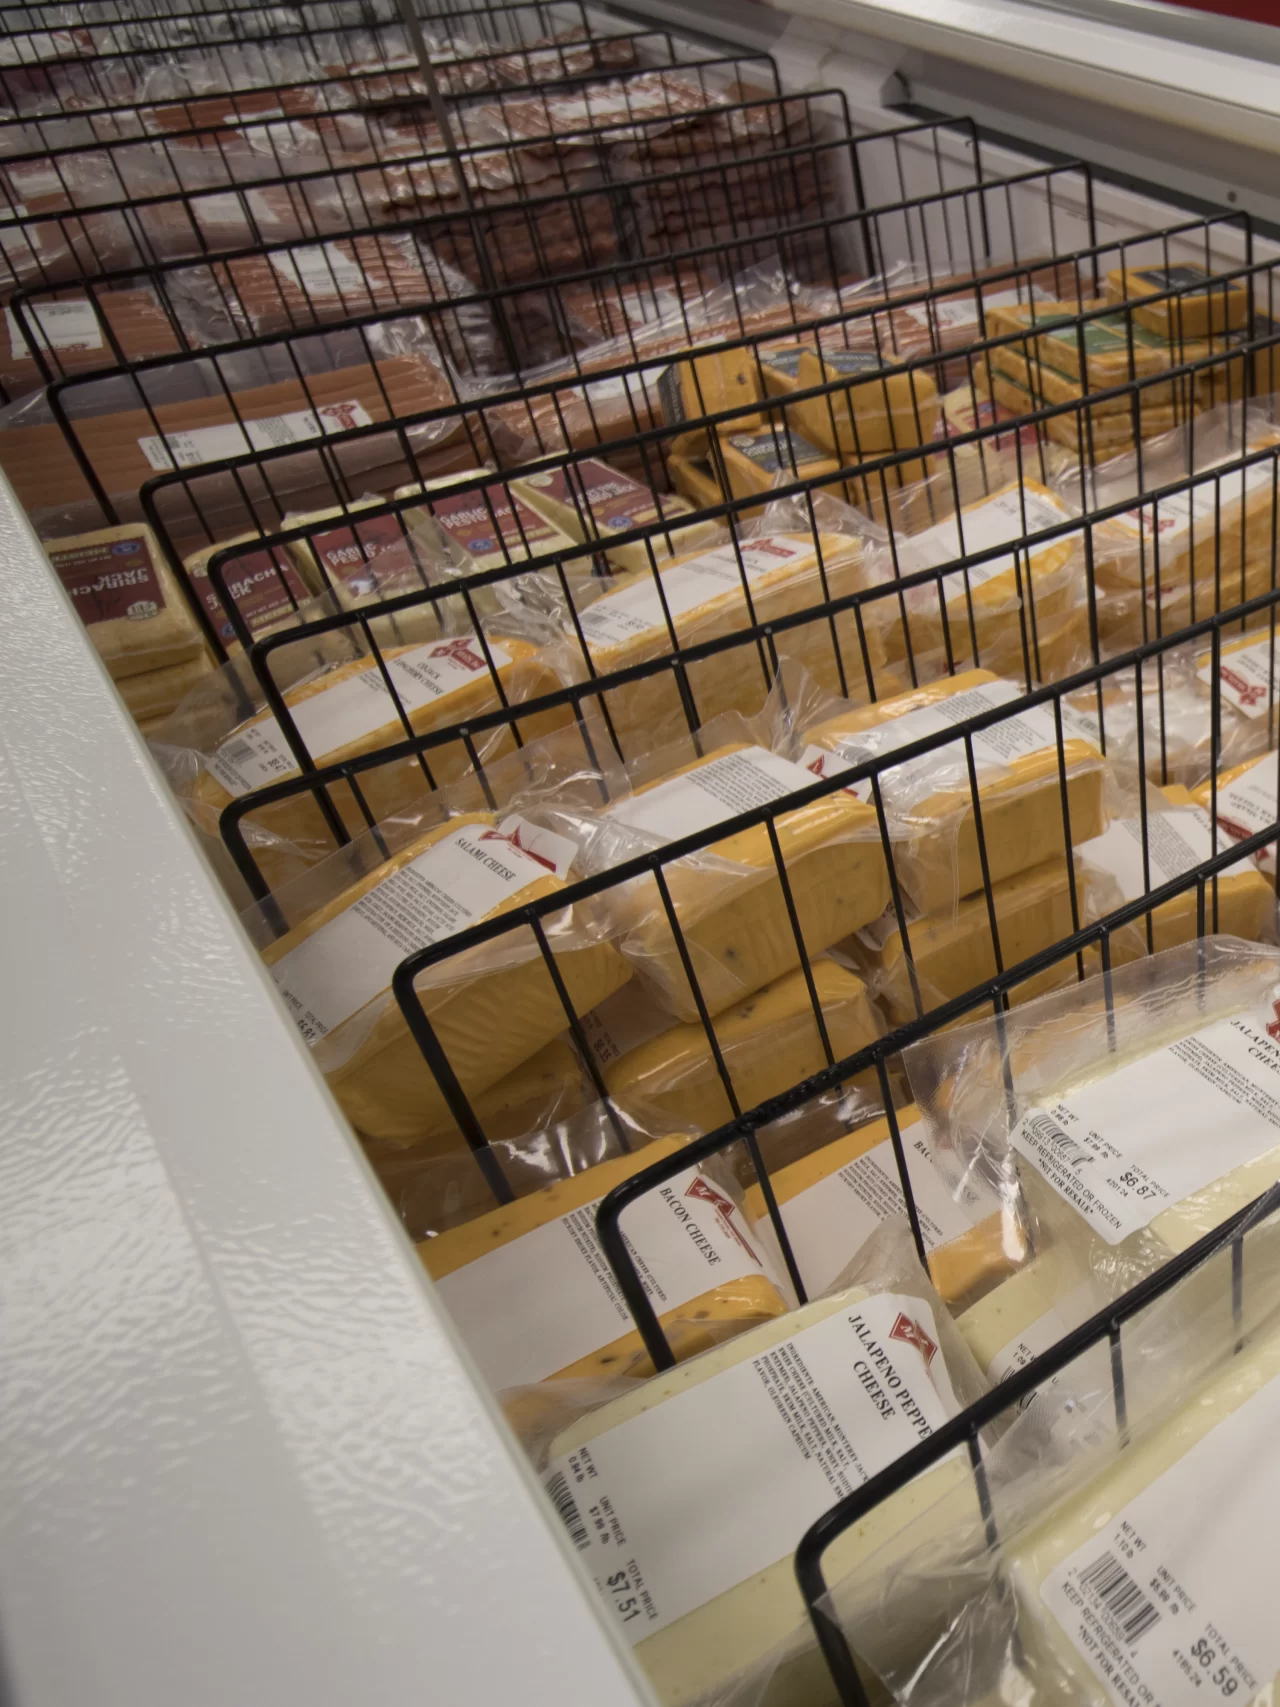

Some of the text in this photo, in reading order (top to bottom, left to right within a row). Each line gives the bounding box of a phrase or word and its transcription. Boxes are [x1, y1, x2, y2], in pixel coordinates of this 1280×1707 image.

[454, 837, 517, 882] SALAMI CHEESE
[1056, 1103, 1080, 1122] NET WT
[1087, 1130, 1123, 1159] UNIT PRICE
[1020, 1129, 1123, 1230] KEEP REFRIGERATED OR FROZEN
[1049, 1172, 1066, 1189] FOR
[1119, 1171, 1157, 1200] $6.87
[1130, 1163, 1171, 1199] TOTAL PRICE
[659, 1187, 722, 1267] BACON CHEESE
[847, 1315, 938, 1443] JALAPENO PEPPE
[853, 1360, 897, 1421] CHEESE
[578, 1446, 599, 1479] NET WT
[599, 1495, 627, 1547] UNIT PRICE
[1119, 1519, 1147, 1552] NET WT
[605, 1569, 641, 1623] $7.51
[626, 1557, 659, 1621] TOTAL PRICE
[1155, 1565, 1197, 1613] UNIT PRICE
[1061, 1580, 1155, 1705] KEEP REFRIGERATED OR
[1093, 1651, 1115, 1677] FOR
[1189, 1637, 1239, 1697] $6.59
[1203, 1623, 1259, 1691] TOTAL PRICE
